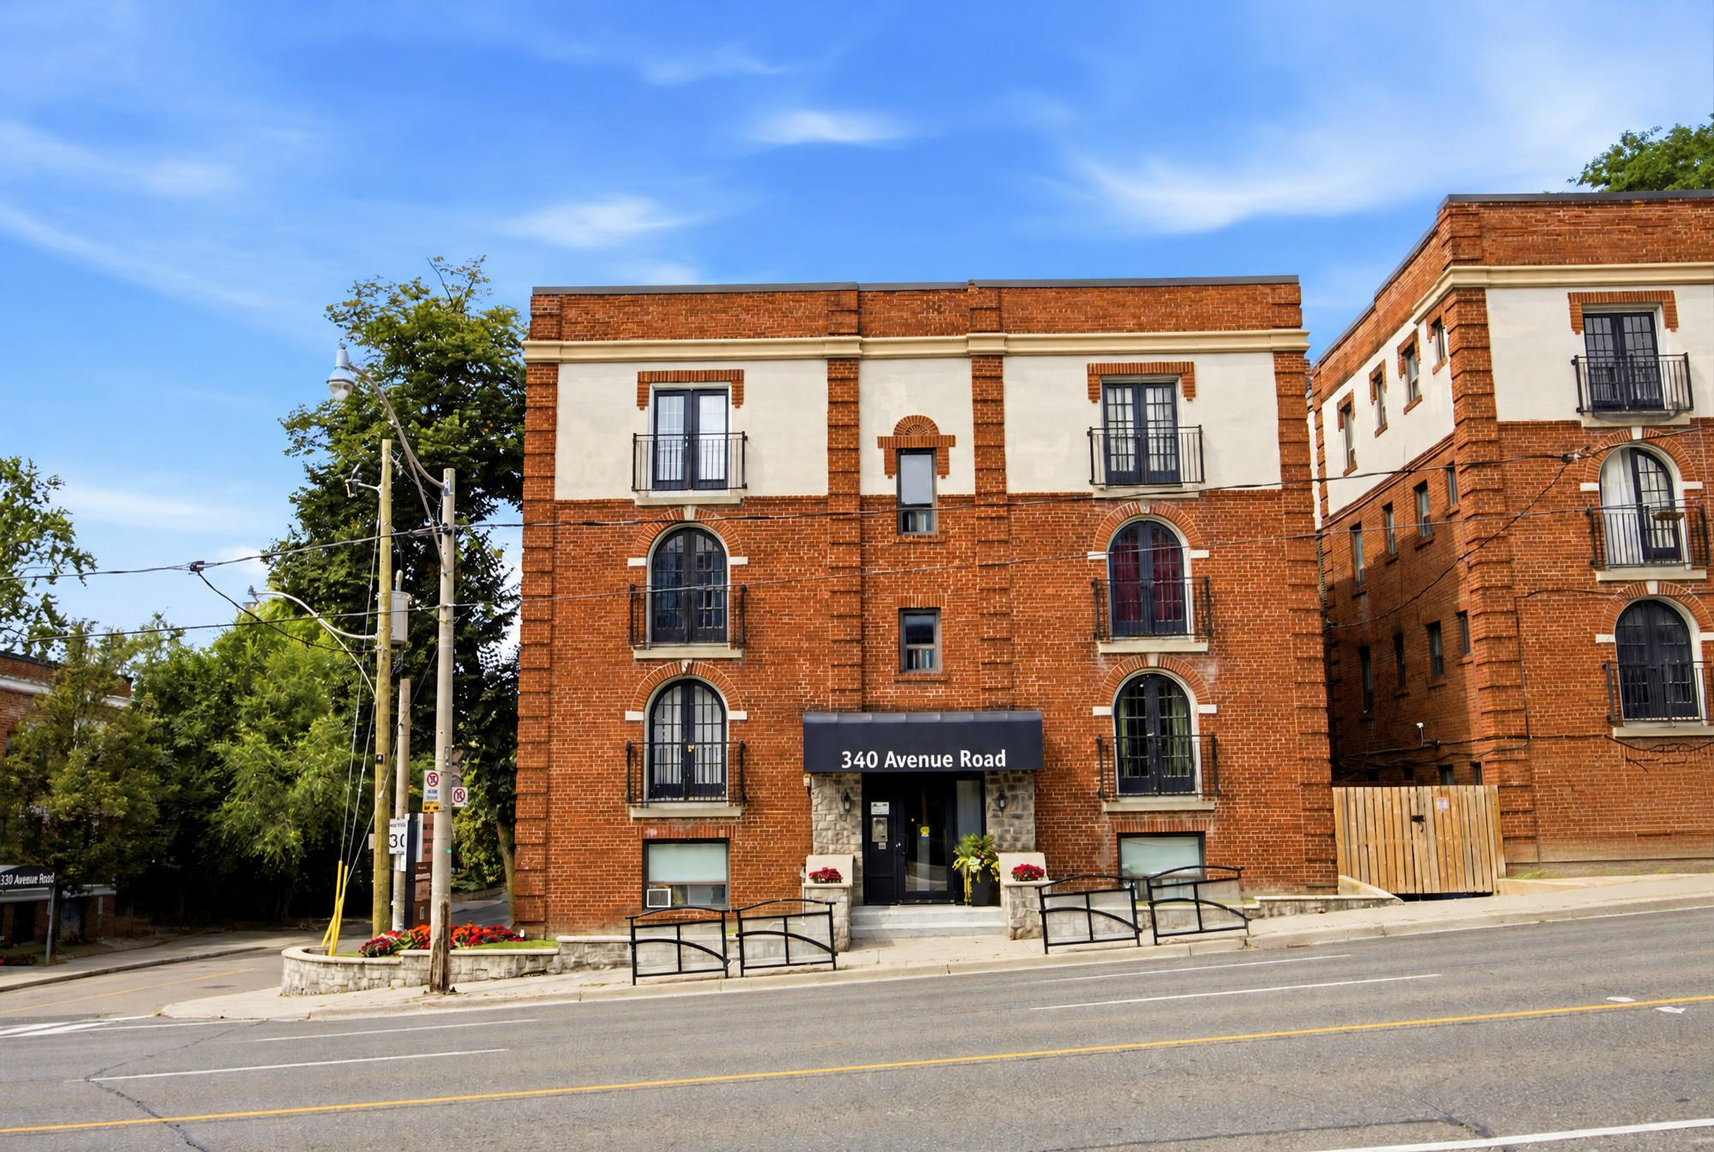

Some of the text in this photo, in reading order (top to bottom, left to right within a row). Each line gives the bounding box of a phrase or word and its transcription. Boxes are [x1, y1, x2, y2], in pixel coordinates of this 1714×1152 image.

[841, 749, 1006, 769] 340 Avenue Road
[13, 874, 38, 885] Avenue
[39, 872, 55, 884] Road
